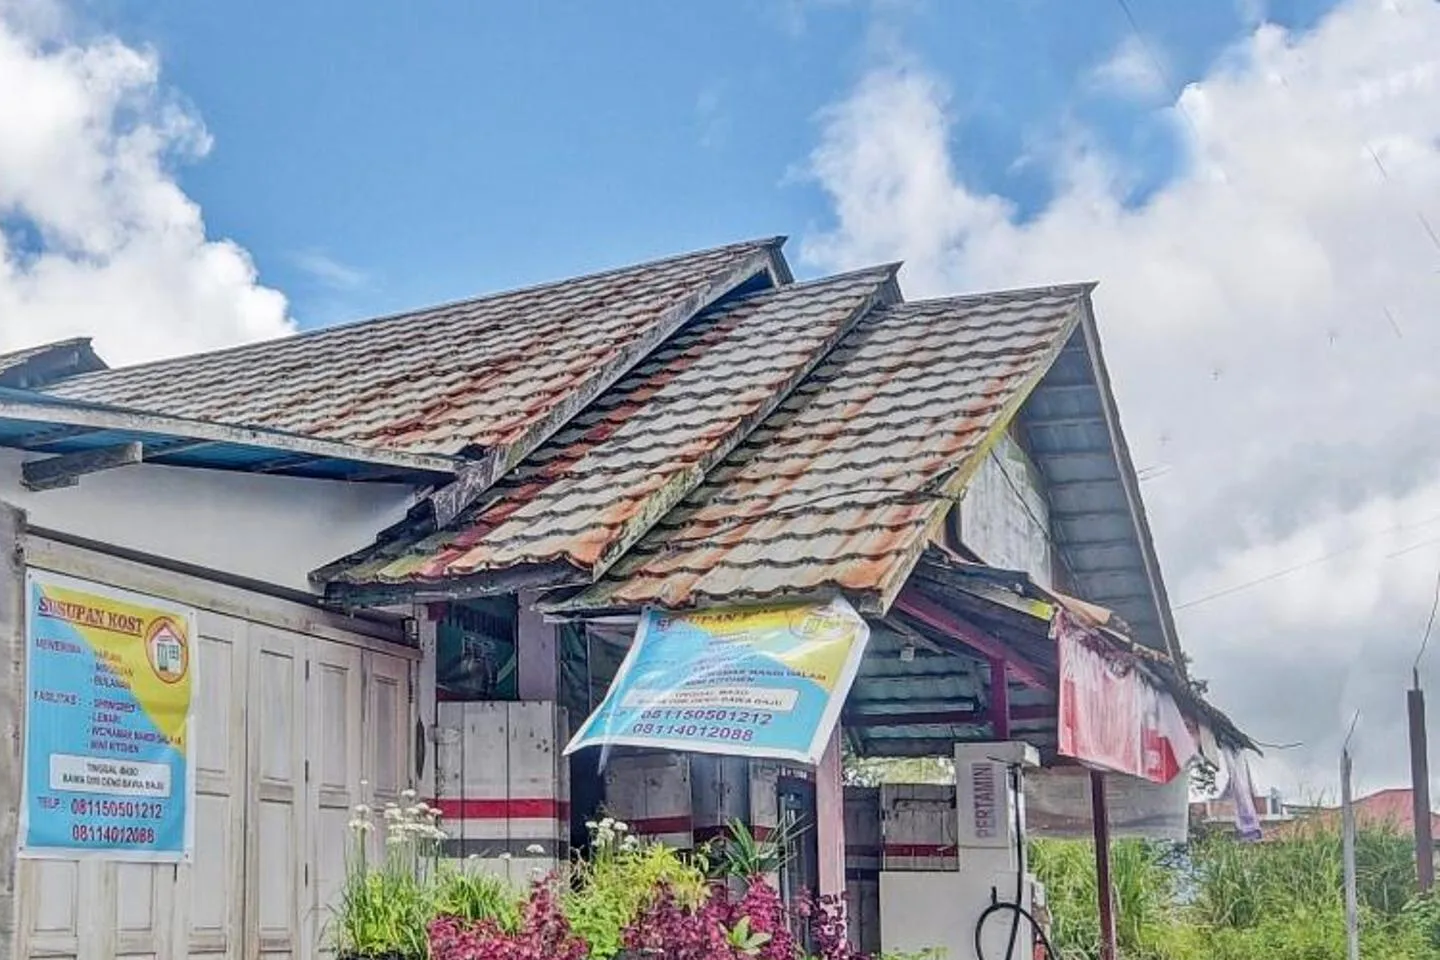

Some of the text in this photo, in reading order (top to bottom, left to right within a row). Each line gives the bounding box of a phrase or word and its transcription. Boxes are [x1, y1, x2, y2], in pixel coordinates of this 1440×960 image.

[108, 610, 144, 632] KOST
[641, 709, 773, 725] 081150501212
[632, 724, 754, 742] 08114012088
[71, 798, 162, 819] 081150501212
[72, 824, 155, 844] 08114012088
